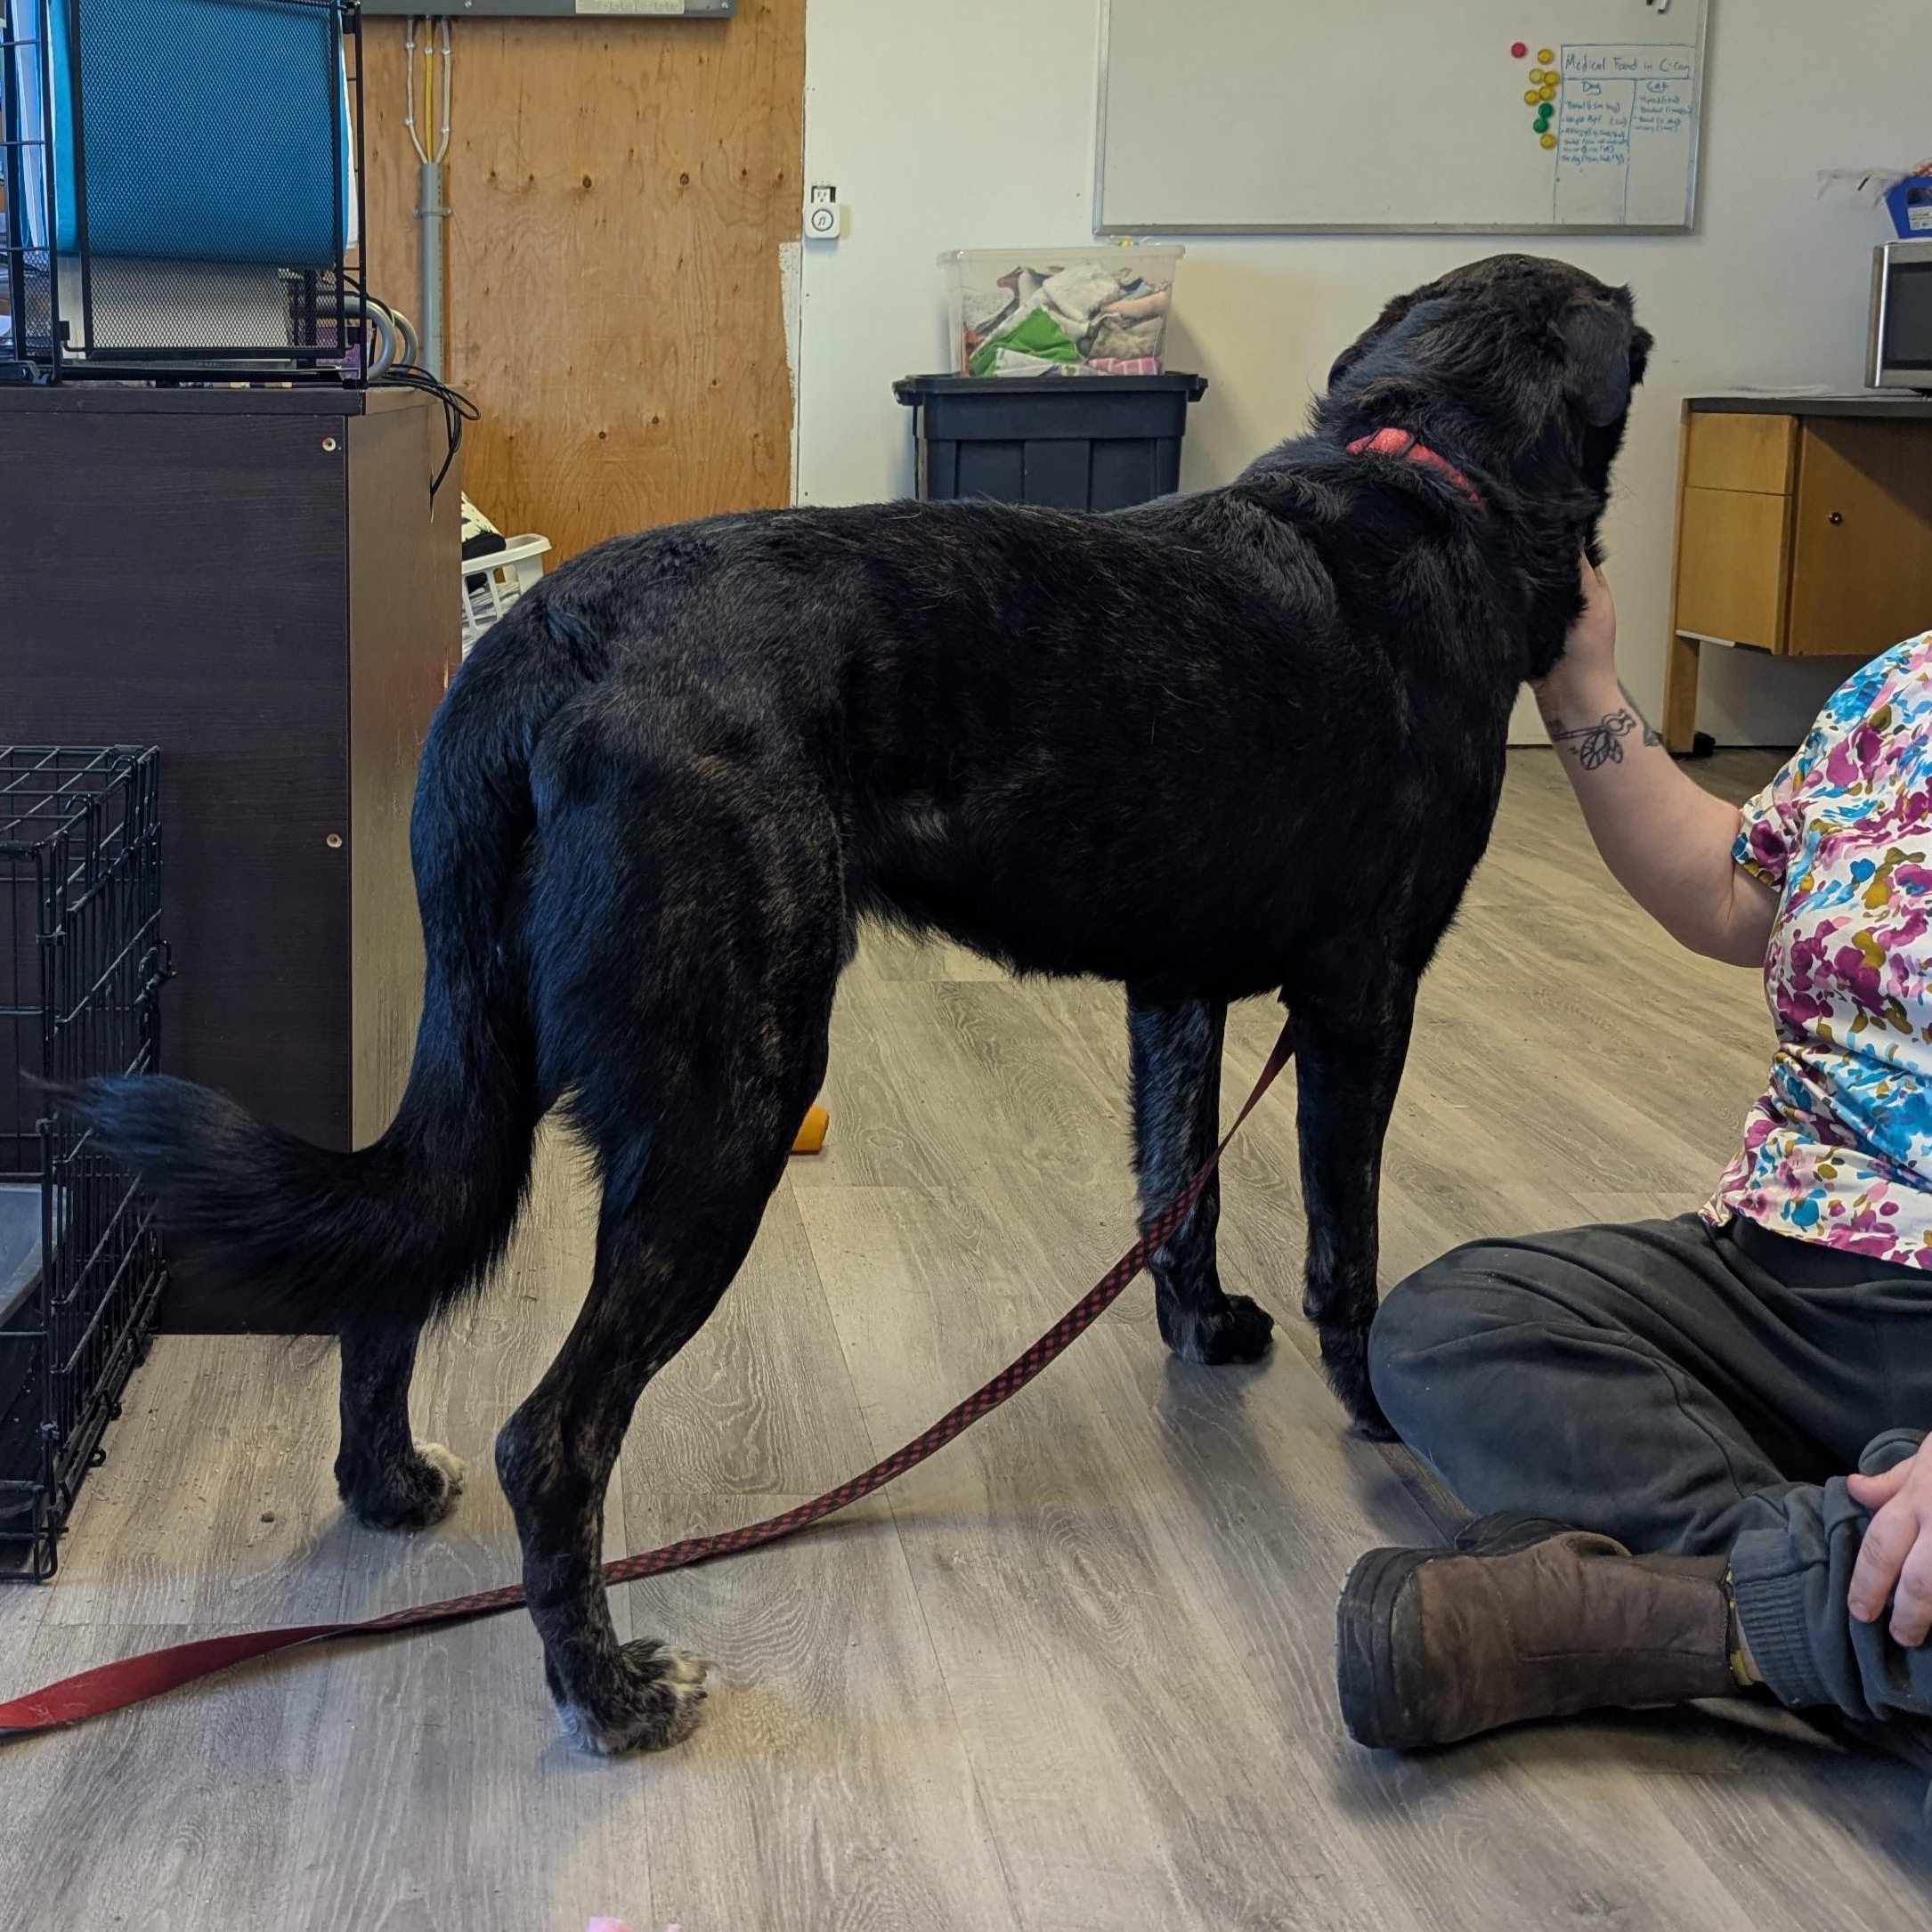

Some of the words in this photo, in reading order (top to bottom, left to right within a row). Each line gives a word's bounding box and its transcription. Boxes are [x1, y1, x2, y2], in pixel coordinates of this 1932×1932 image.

[1565, 53, 1605, 72] Medical
[1612, 57, 1637, 71] Food
[1581, 81, 1602, 95] Dog
[1646, 81, 1668, 93] Cat
